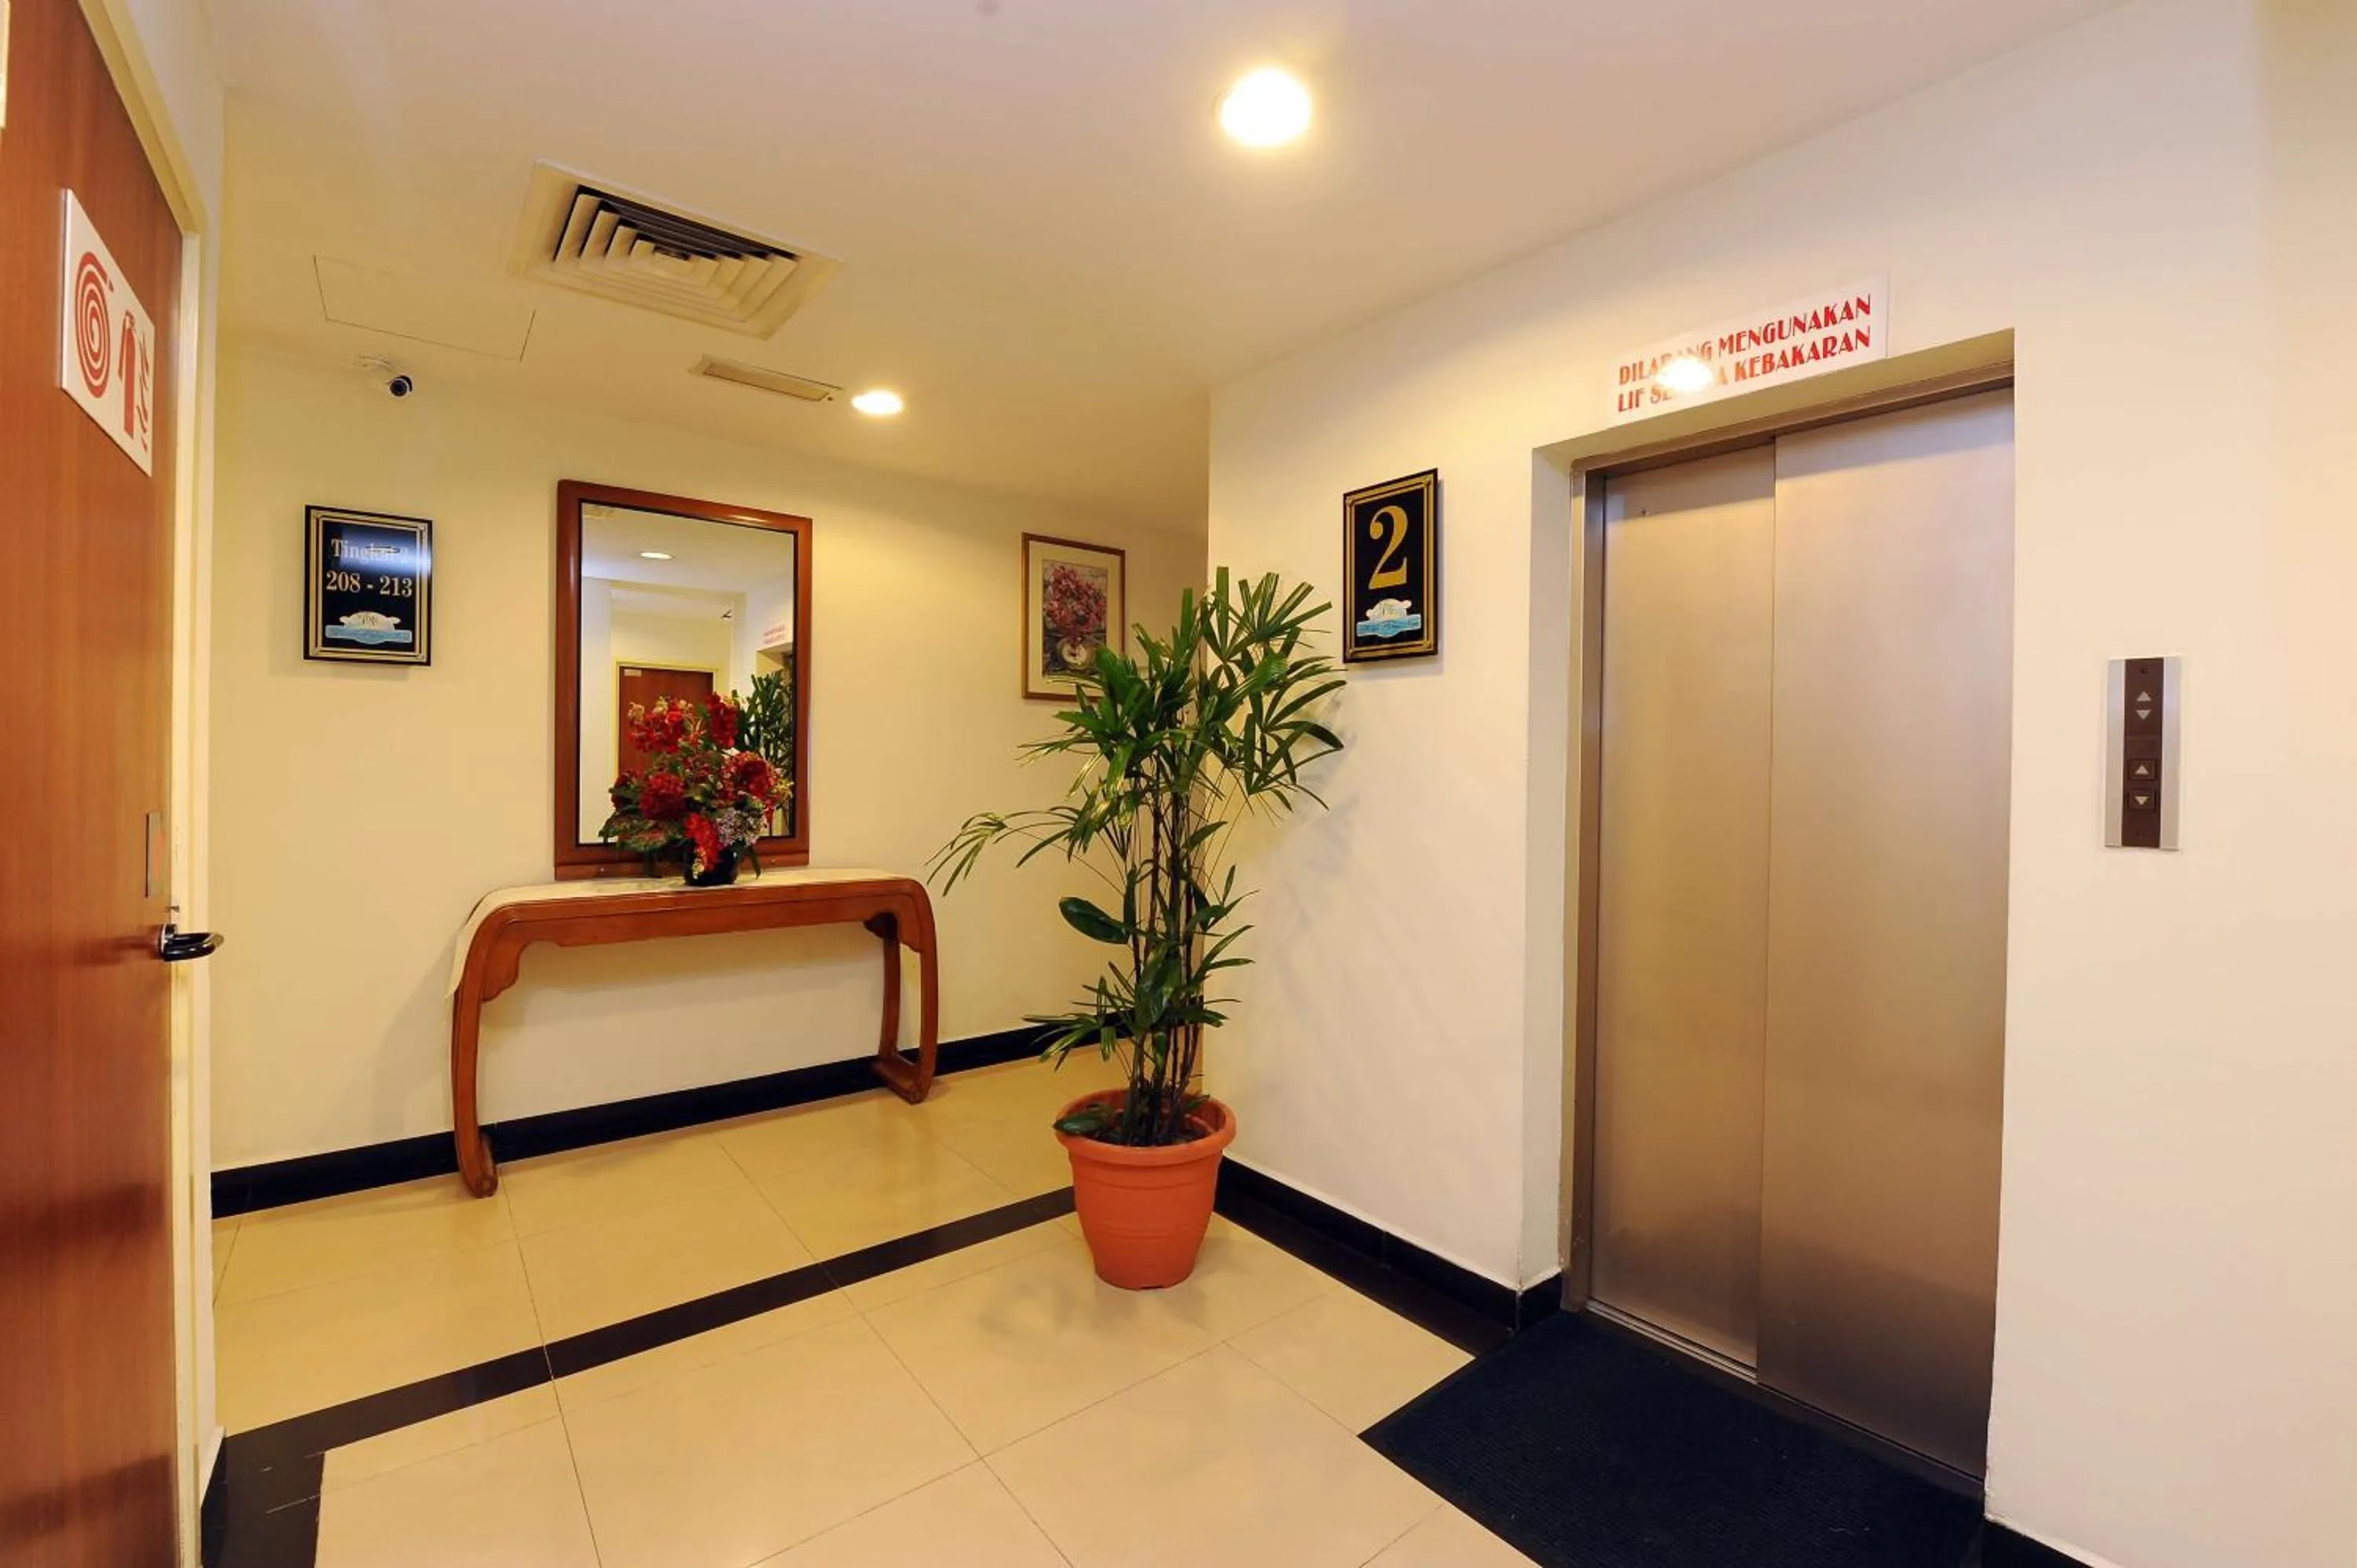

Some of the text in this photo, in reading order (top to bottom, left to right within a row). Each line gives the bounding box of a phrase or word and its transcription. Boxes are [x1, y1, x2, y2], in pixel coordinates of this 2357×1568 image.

[1618, 293, 1871, 386] DILANG MENGUNAKAN
[1618, 324, 1871, 412] LIF SEA KEBAKARAN
[326, 570, 361, 593] 208
[379, 575, 412, 598] 213
[1368, 505, 1409, 590] 2
